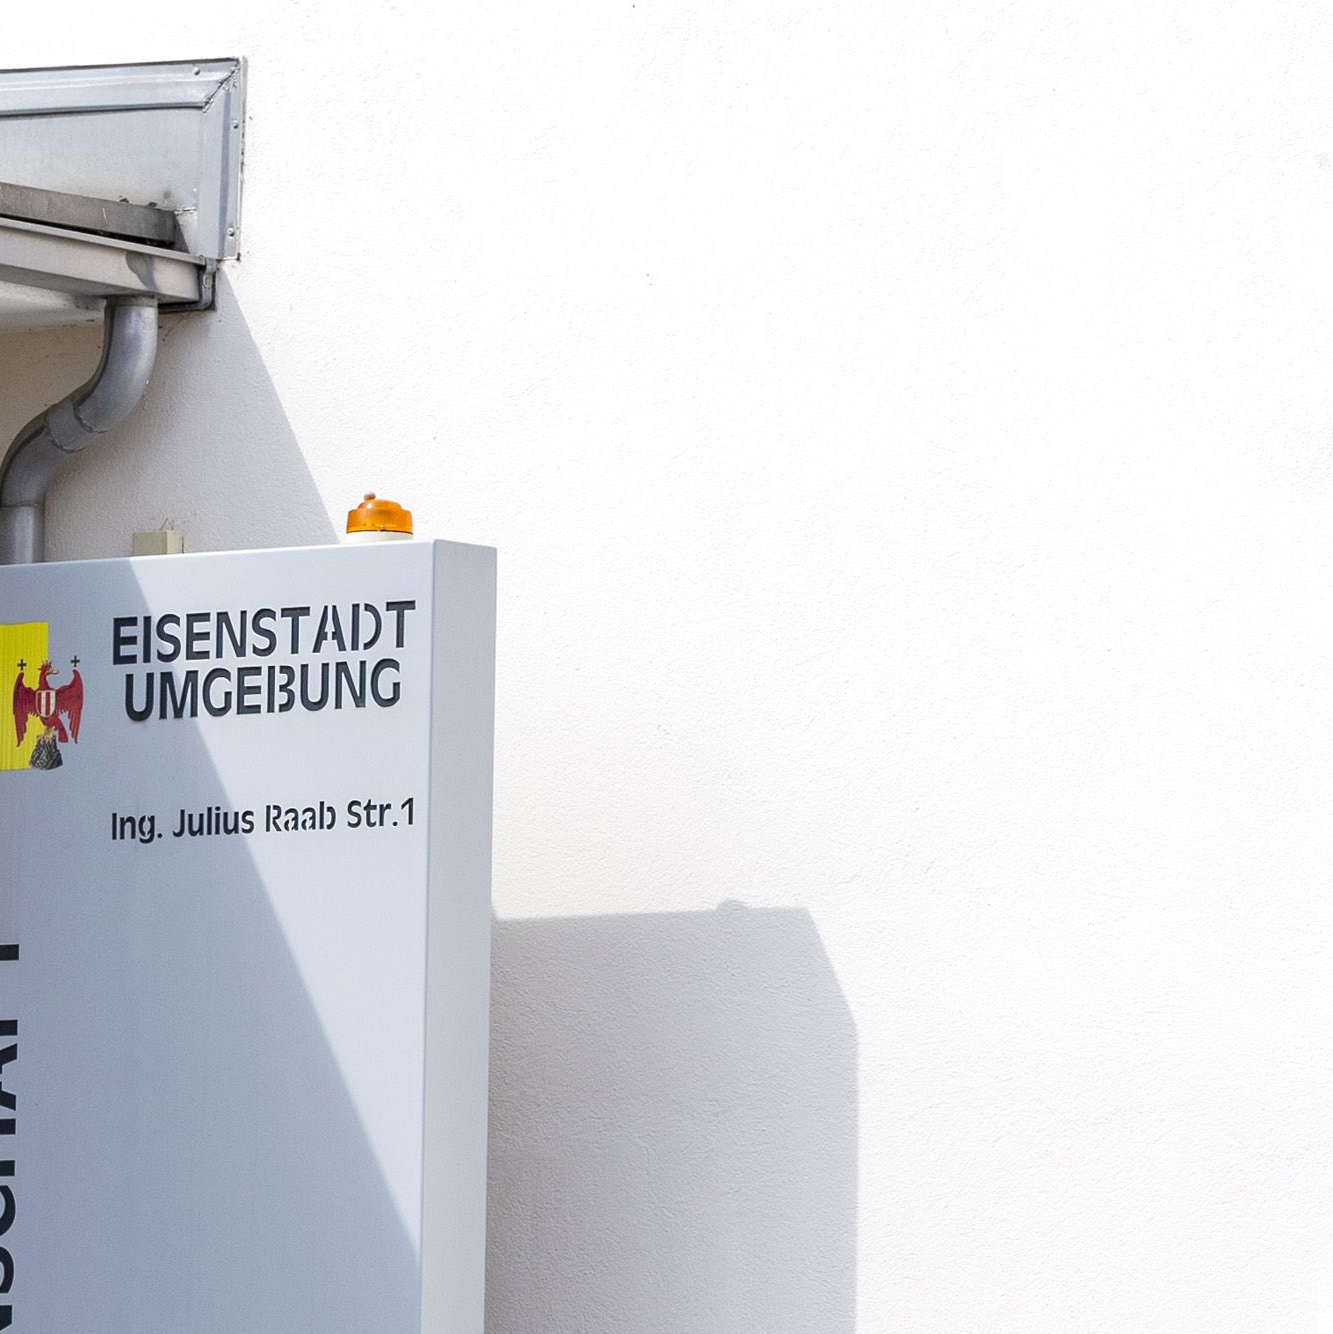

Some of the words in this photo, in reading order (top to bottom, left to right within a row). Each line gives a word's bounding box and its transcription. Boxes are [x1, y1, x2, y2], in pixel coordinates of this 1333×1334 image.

[113, 600, 416, 665] EISENSTADT
[125, 658, 401, 722] UMGEBUNG
[111, 812, 164, 844] Ing.
[173, 806, 255, 839] Julius
[265, 801, 336, 833] Raab
